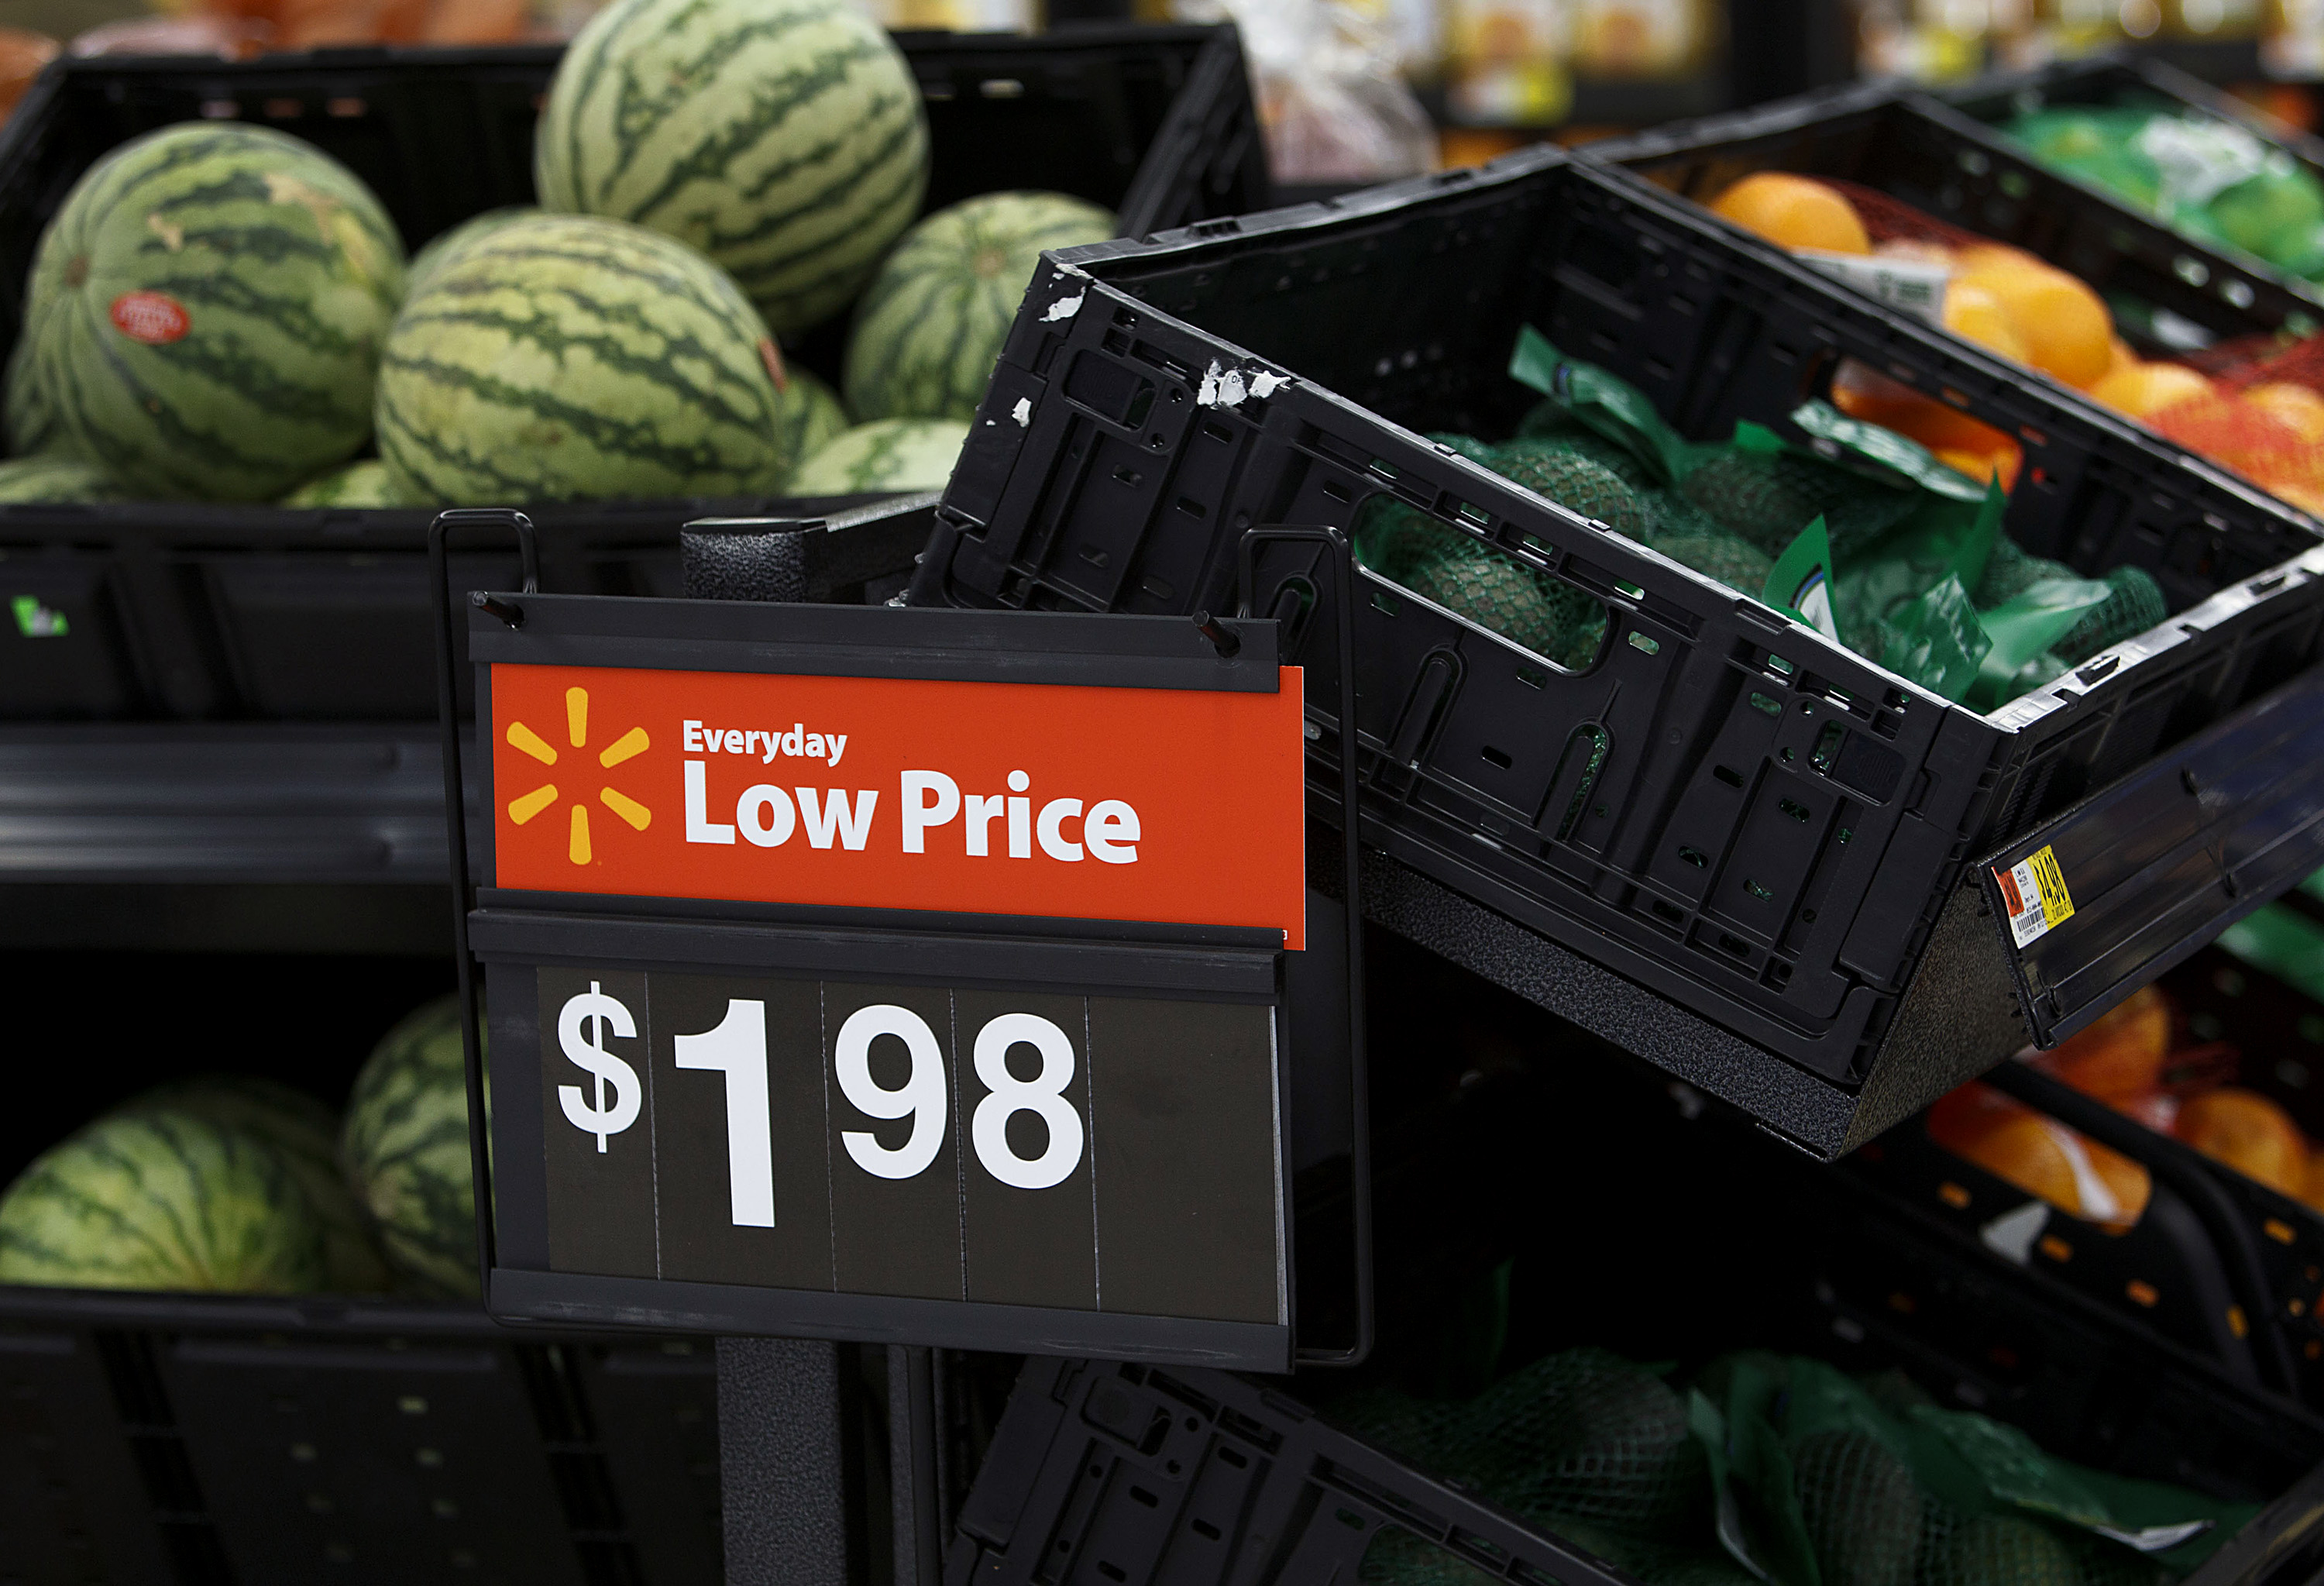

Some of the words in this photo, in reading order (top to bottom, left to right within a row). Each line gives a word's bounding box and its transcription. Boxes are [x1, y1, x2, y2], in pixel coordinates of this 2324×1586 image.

[682, 719, 848, 767] Everyday
[683, 759, 880, 851] Low
[900, 769, 1142, 864] Price
